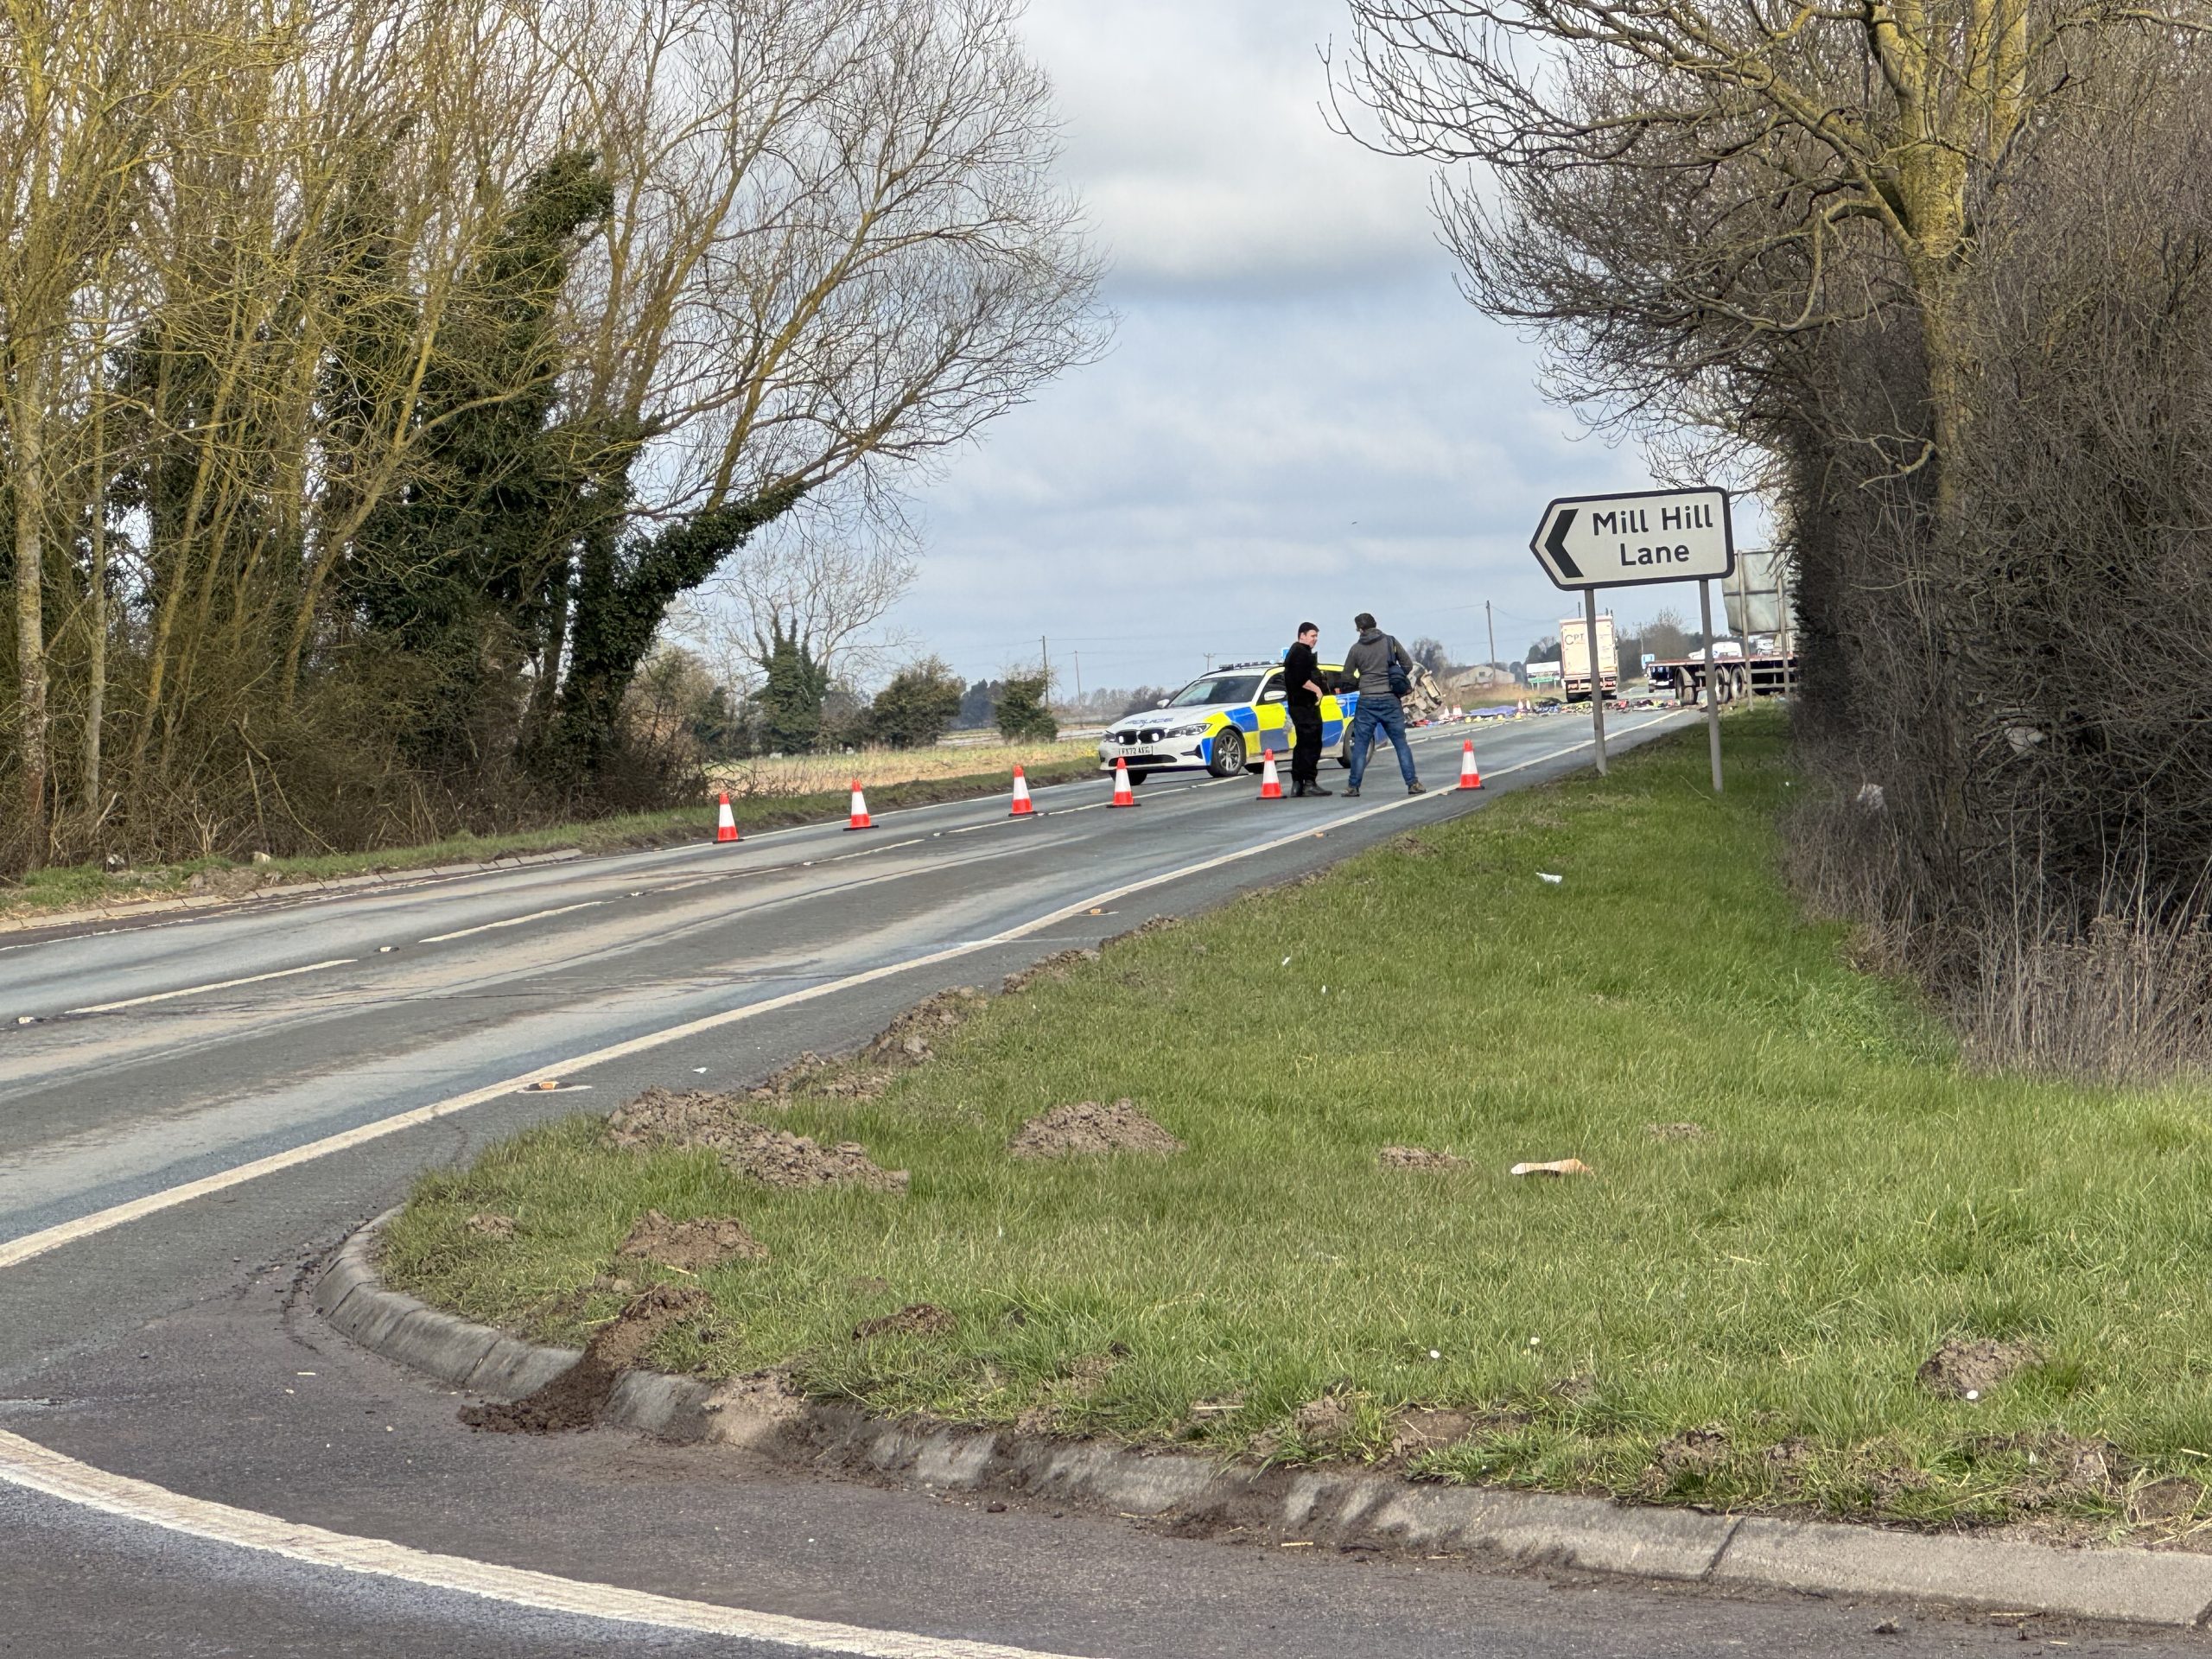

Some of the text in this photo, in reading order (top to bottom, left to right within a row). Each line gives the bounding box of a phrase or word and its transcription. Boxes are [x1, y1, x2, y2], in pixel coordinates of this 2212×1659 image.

[1592, 504, 1713, 536] Mill Hill
[1620, 543, 1689, 566] Lane
